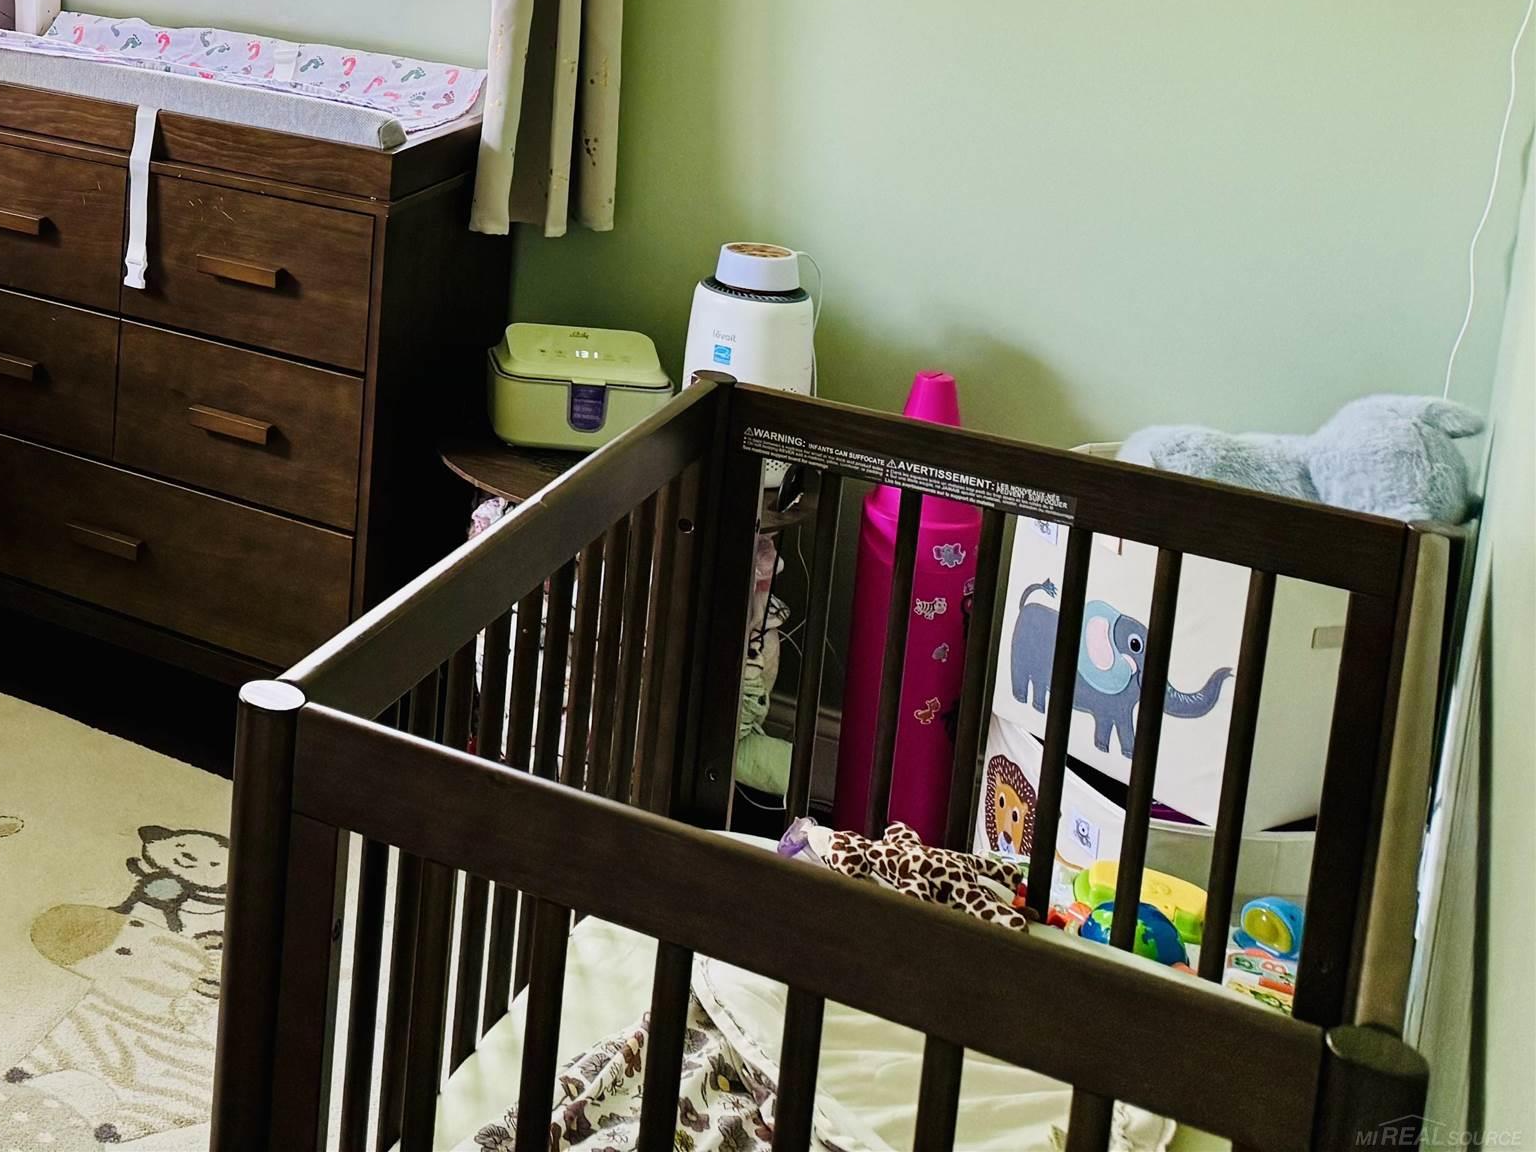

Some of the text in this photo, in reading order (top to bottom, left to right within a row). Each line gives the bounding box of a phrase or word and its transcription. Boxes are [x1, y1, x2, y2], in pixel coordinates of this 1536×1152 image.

[753, 428, 806, 447] WARNING:
[808, 443, 834, 455] INFANTS
[834, 449, 848, 458] CAN
[848, 452, 885, 466] SUFFOCATE
[897, 460, 995, 490] AVERTISSEMENT:
